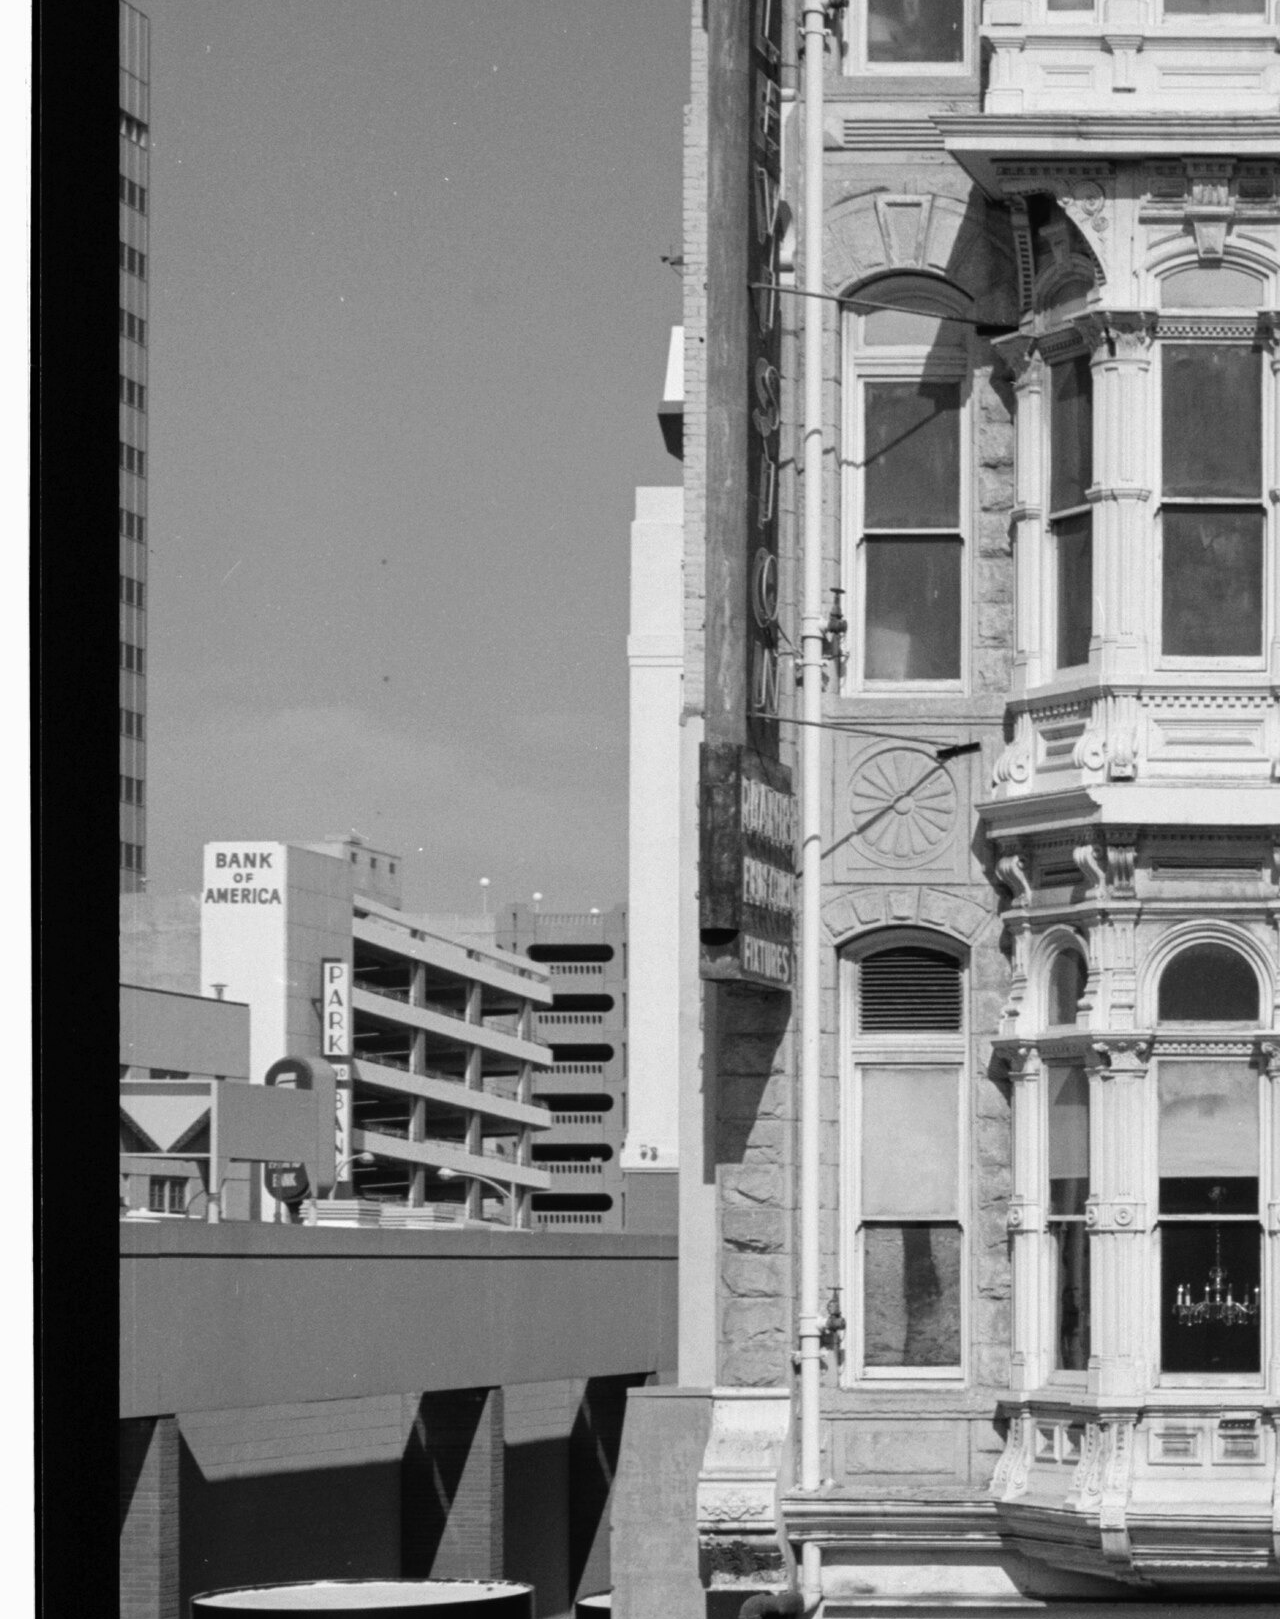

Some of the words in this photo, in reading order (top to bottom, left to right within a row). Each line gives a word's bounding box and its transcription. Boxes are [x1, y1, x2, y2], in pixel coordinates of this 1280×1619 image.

[215, 852, 273, 869] BANK
[232, 872, 254, 884] OF
[204, 887, 282, 905] AMERICA
[328, 965, 344, 1053] PARK
